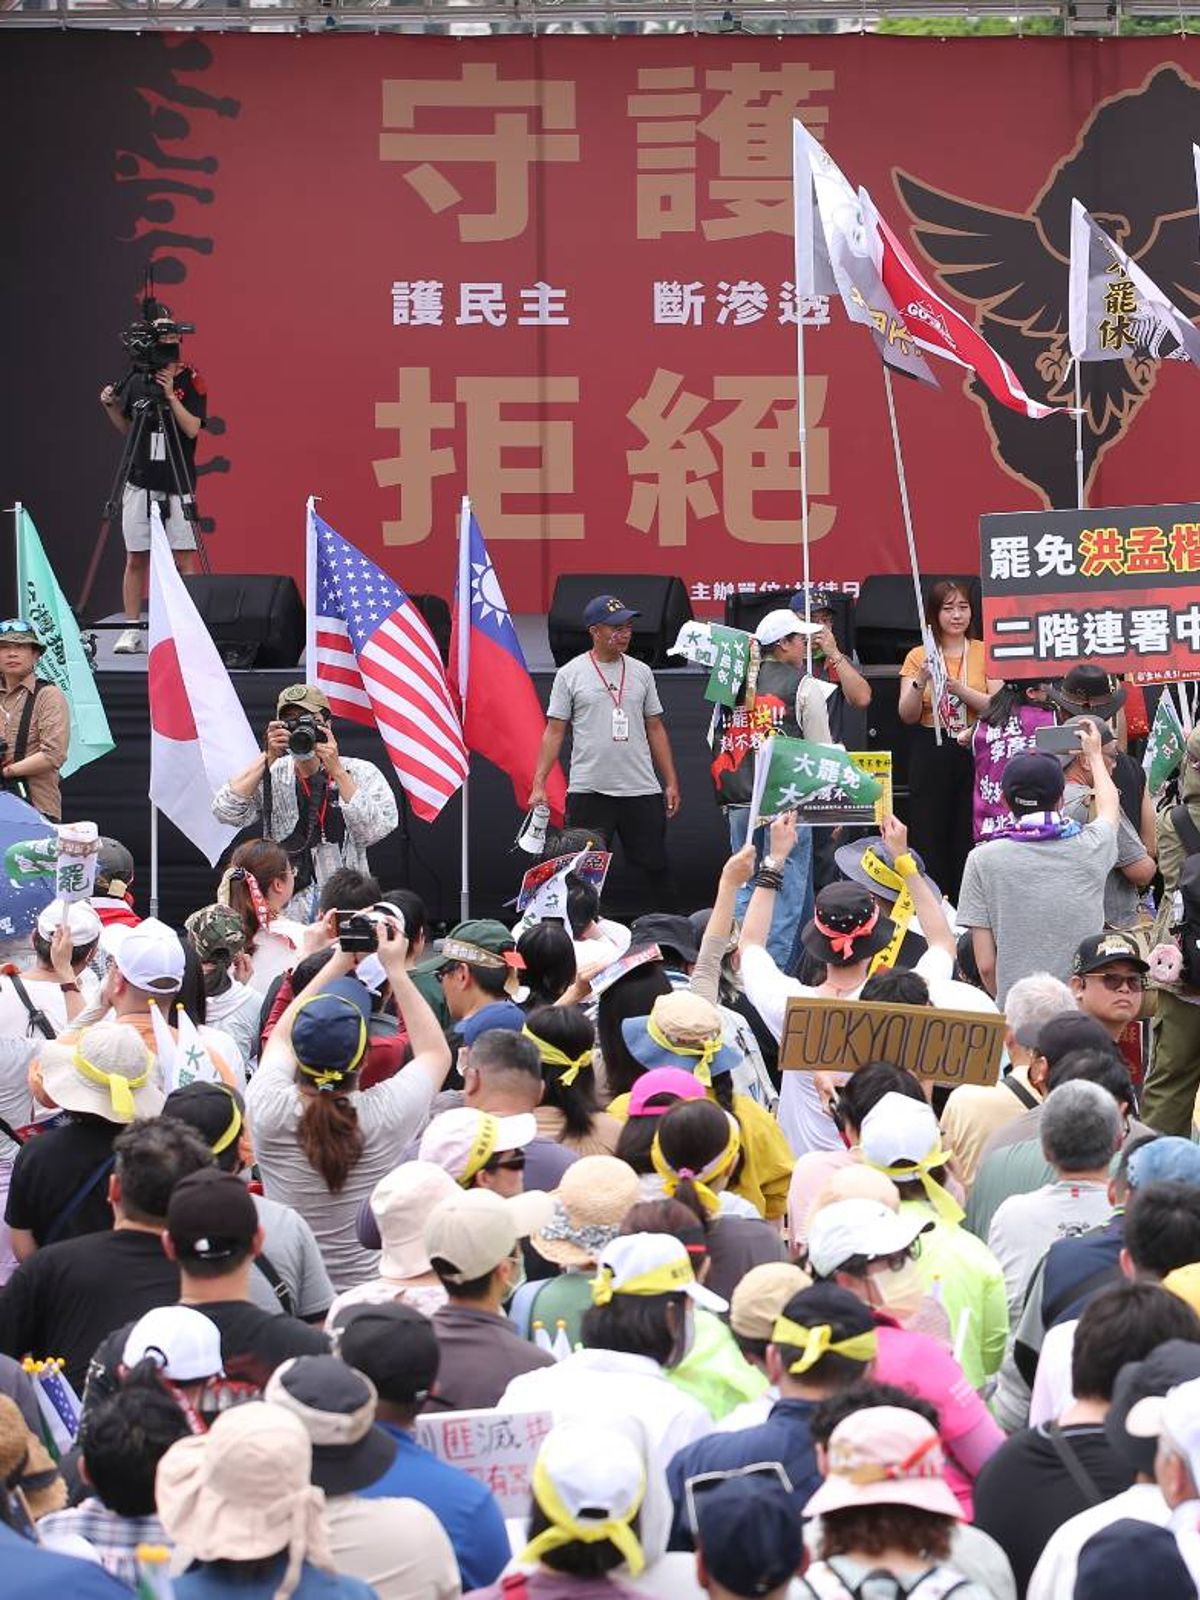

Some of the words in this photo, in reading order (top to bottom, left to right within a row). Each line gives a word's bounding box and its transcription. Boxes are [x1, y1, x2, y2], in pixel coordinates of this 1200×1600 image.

[379, 62, 836, 242] 守護
[391, 280, 570, 326] 護民主
[652, 280, 831, 326] 斷滲透
[373, 366, 838, 547] 拒絕
[793, 752, 862, 791] 大罷免
[58, 863, 90, 893] 罷
